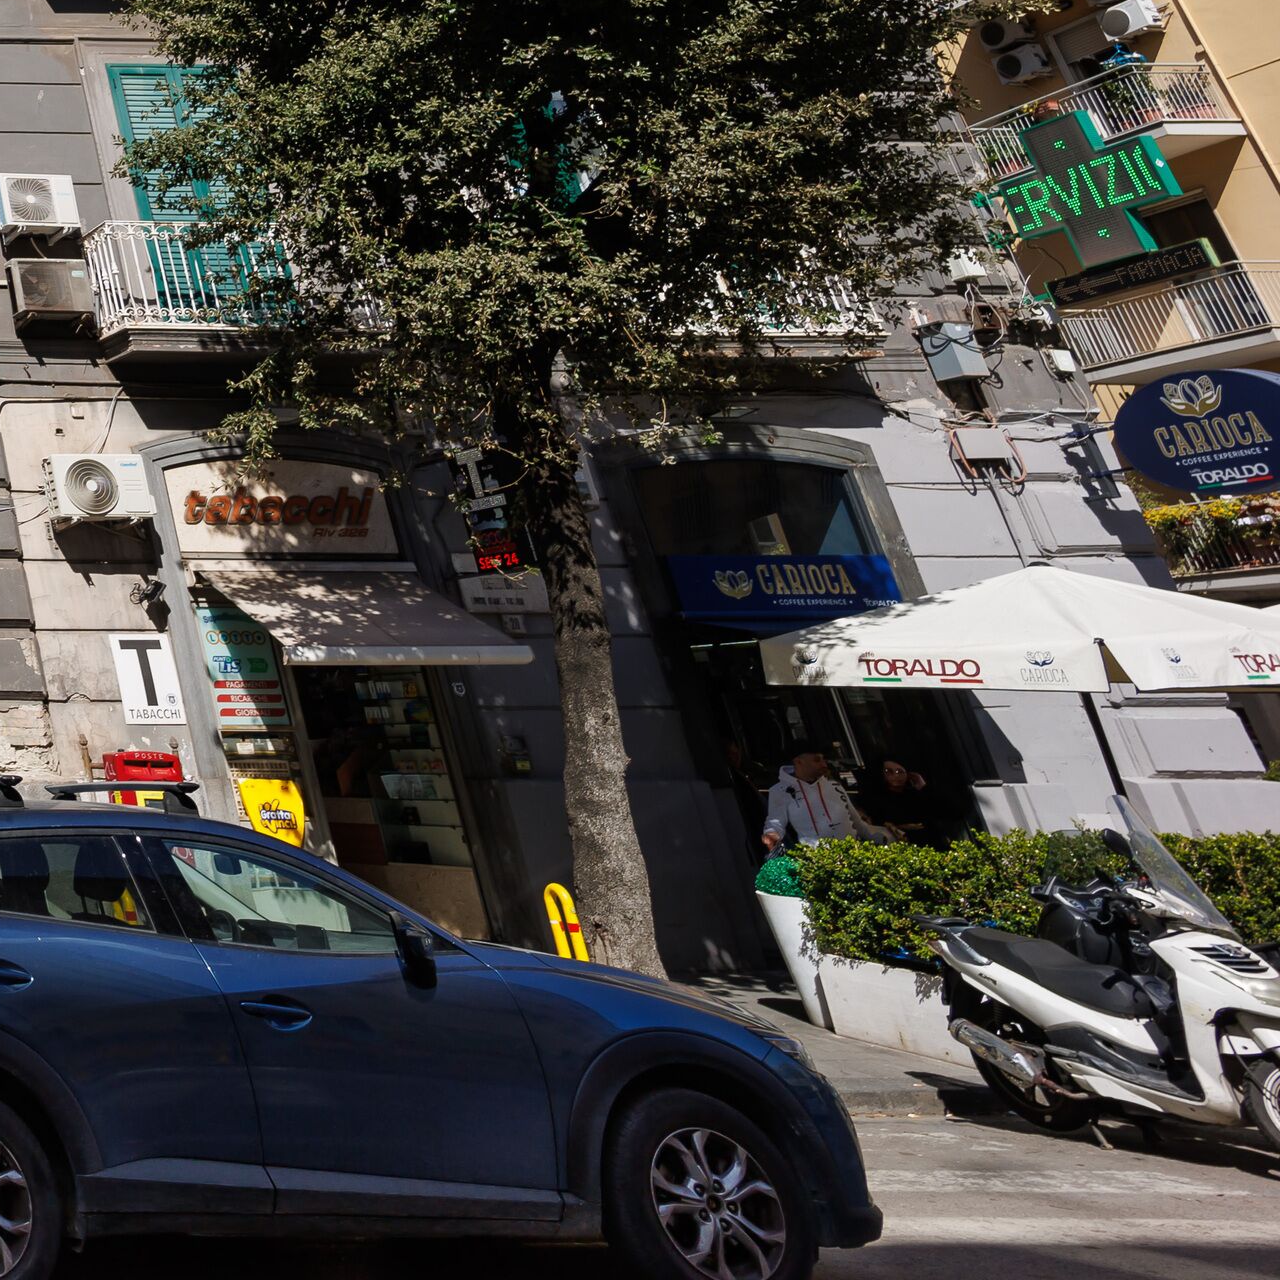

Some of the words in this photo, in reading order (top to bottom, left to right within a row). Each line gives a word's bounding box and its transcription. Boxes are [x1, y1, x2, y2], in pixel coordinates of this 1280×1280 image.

[1116, 246, 1207, 285] FARMACIA
[1153, 410, 1273, 459] CARIOCA
[1181, 455, 1211, 466] COFFEE
[1214, 447, 1263, 463] EXPERIENCE
[1191, 462, 1270, 485] TORALDO
[184, 486, 376, 526] tabacchi
[756, 563, 856, 595] CARIOCA
[778, 598, 806, 606] COFFEE
[807, 598, 849, 606] EXPERIENCE
[118, 639, 162, 707] T
[858, 658, 981, 678] TORALDO
[1019, 668, 1070, 683] CARIOCA
[128, 708, 182, 720] TABACCHI
[134, 752, 164, 760] POSTE
